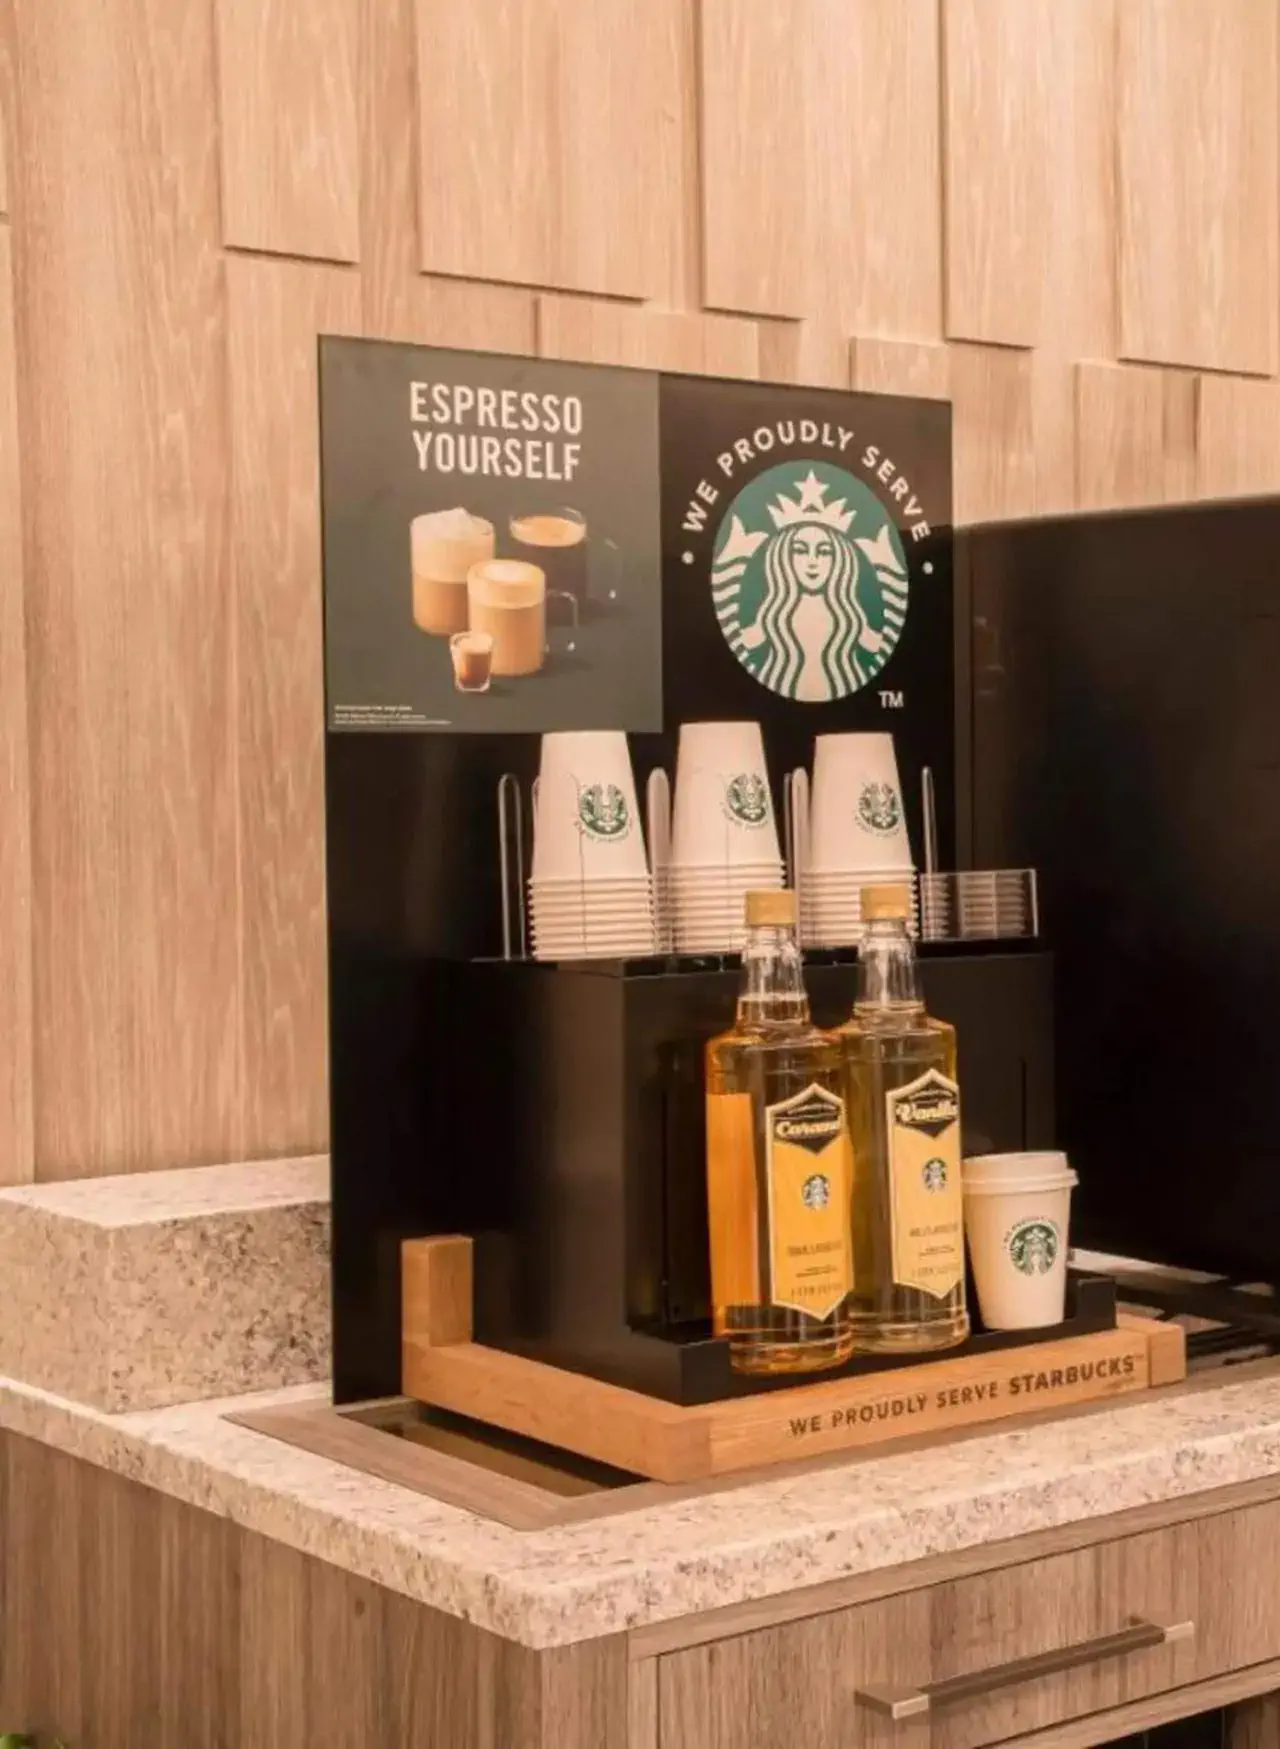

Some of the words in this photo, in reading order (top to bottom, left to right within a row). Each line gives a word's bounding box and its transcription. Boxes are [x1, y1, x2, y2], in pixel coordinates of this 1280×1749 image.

[410, 381, 583, 436] ESPRESSO
[412, 430, 582, 482] YOURSELF
[682, 480, 719, 533] WE
[716, 420, 855, 478] PROUDLY
[861, 446, 932, 543] SERVE
[878, 691, 904, 708] TM
[788, 1417, 822, 1438] WE
[832, 1393, 928, 1429] PROUDLY
[936, 1380, 999, 1410] SERVE
[1008, 1354, 1136, 1396] STARBUCKS
